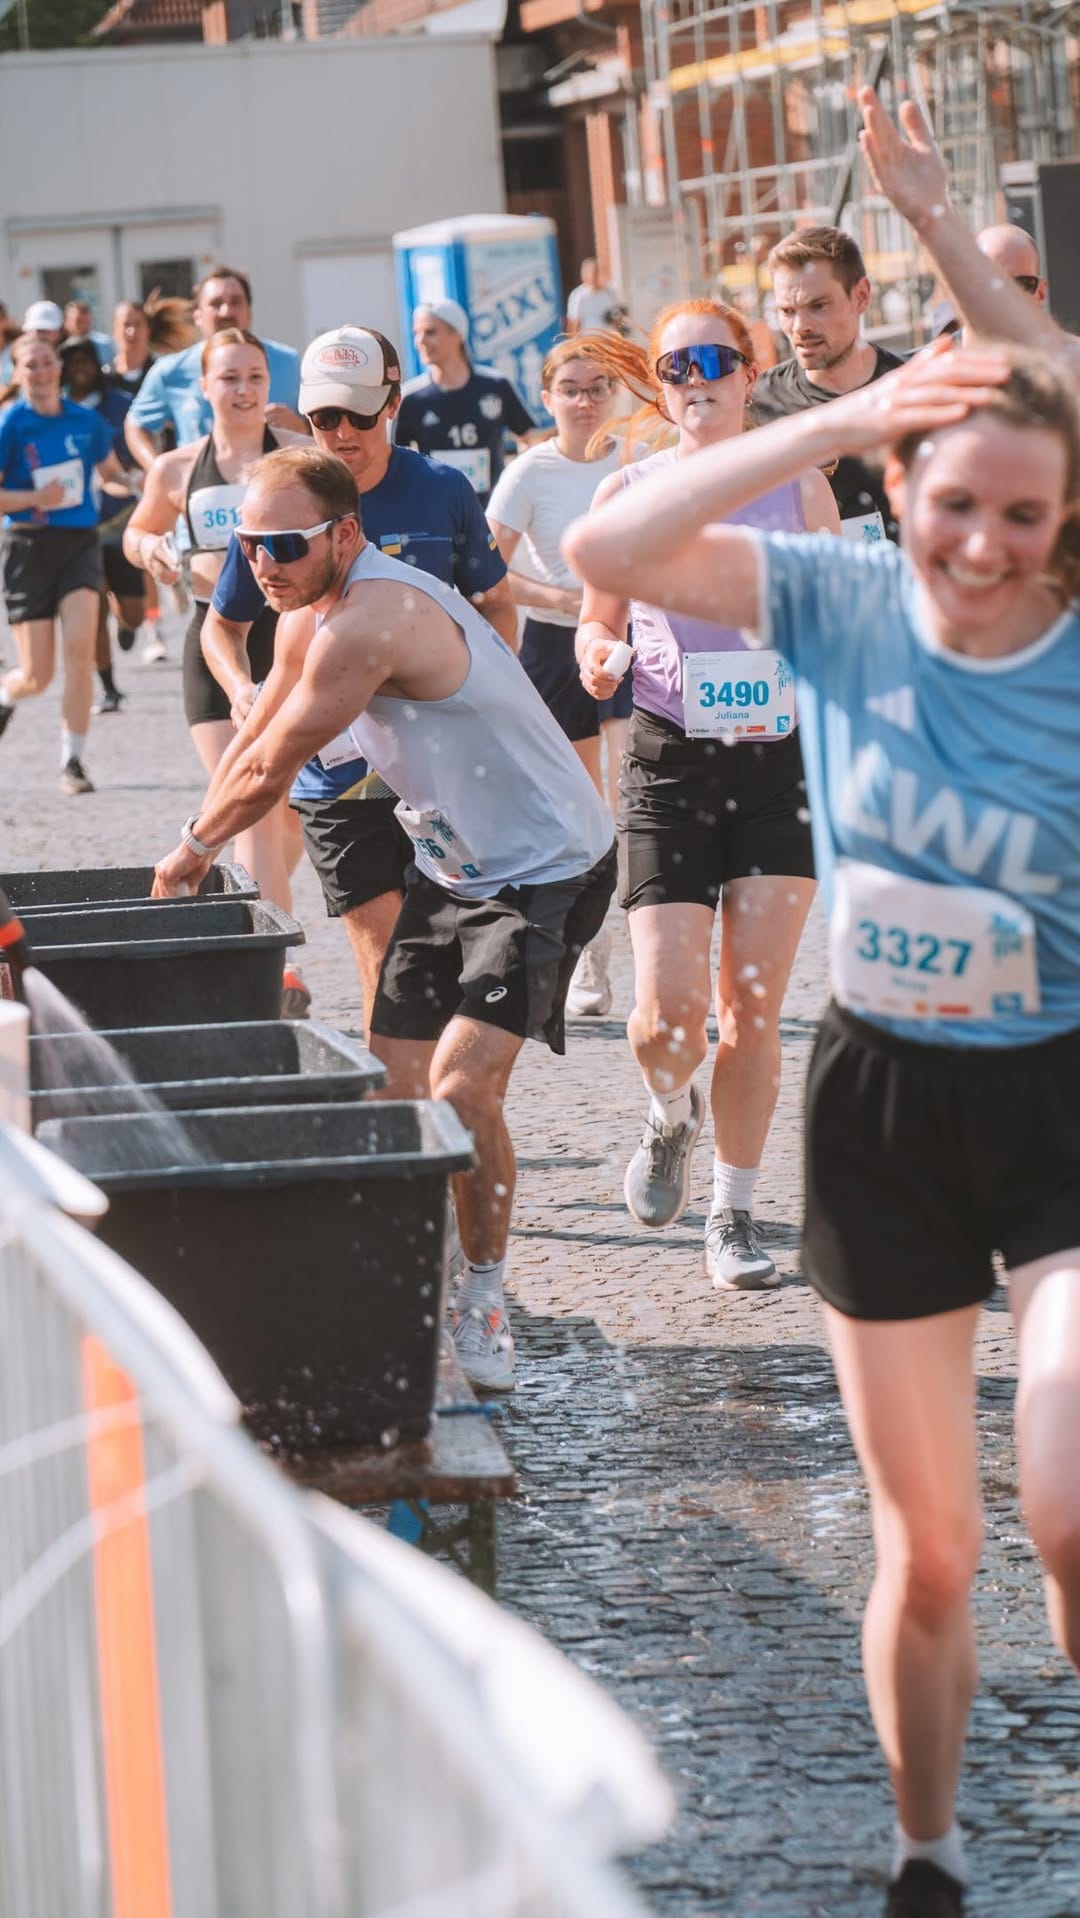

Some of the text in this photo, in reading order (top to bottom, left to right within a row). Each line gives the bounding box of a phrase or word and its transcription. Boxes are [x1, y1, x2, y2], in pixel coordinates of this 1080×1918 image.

[448, 423, 478, 448] 16
[700, 680, 770, 708] 3490
[715, 711, 750, 720] Juliana
[856, 918, 975, 978] 3327
